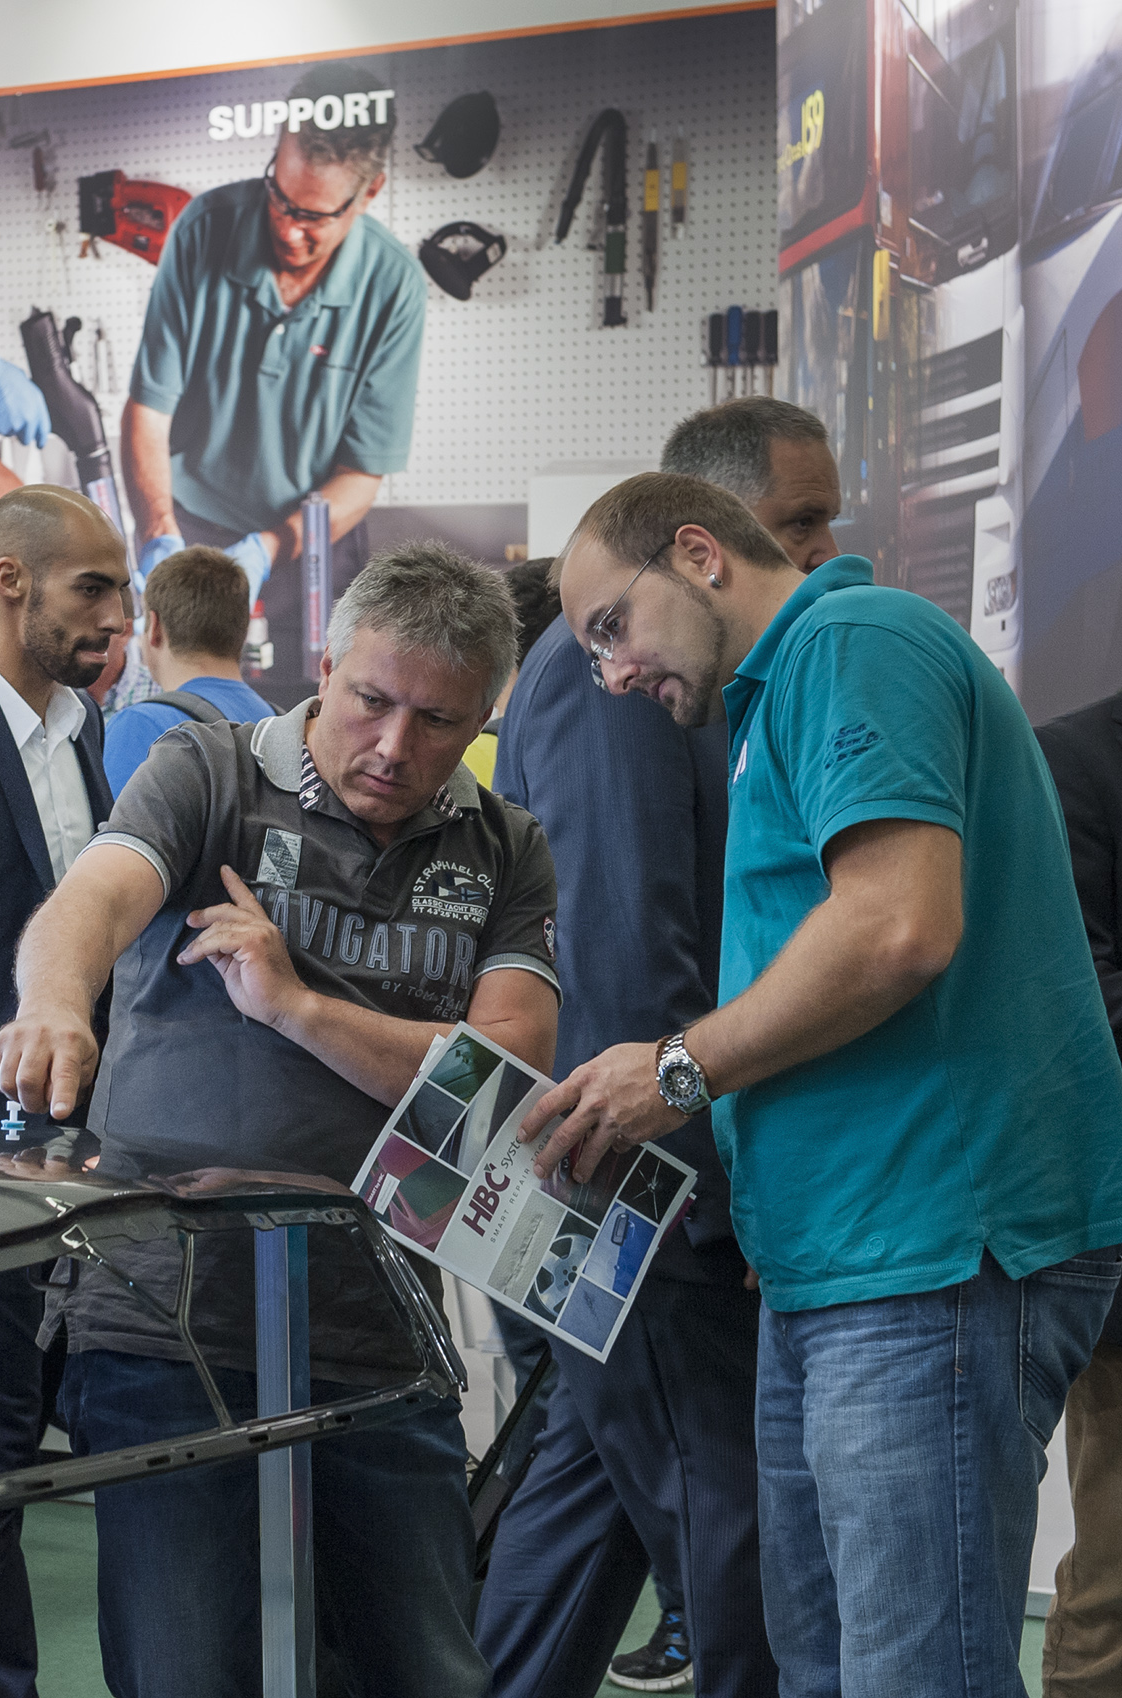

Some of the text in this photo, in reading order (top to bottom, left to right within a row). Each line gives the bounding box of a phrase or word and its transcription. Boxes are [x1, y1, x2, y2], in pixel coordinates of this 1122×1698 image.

[208, 89, 395, 141] SUPPORT
[255, 888, 475, 990] AVIGATOR
[444, 904, 469, 912] YACHT
[381, 980, 402, 993] BY
[407, 985, 436, 1001] TOM
[461, 1163, 511, 1237] HBC
[490, 1209, 510, 1243] SMART
[509, 1168, 530, 1204] REPAIR
